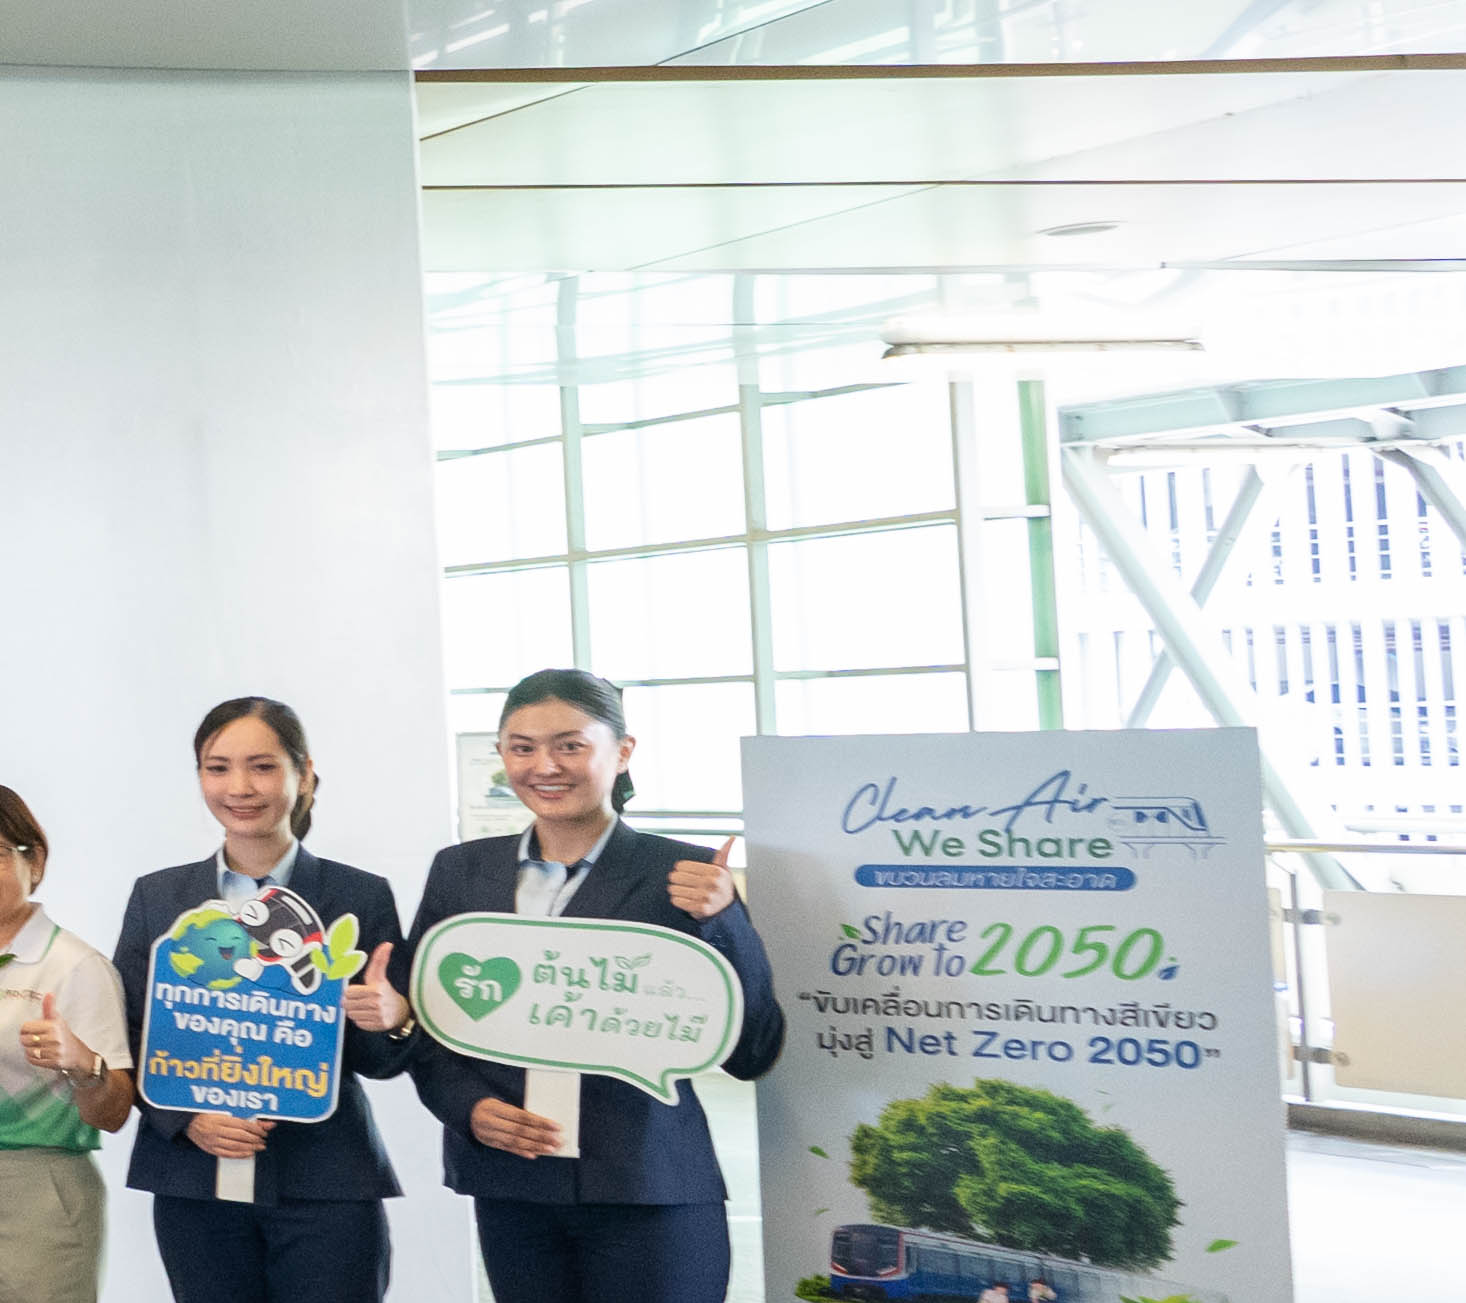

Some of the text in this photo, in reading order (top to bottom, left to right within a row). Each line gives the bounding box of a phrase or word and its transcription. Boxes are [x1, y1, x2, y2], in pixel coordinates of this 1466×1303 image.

[841, 770, 1111, 835] Clean Air
[892, 828, 1115, 860] We Share
[860, 910, 968, 947] Share
[830, 942, 924, 978] Grow
[968, 921, 1166, 982] 2050
[453, 963, 504, 1002] รัก
[155, 981, 337, 1025] ทุกการเดินทาง
[172, 1011, 314, 1048] ของคุณ คือ
[885, 1027, 958, 1058] Net
[972, 1030, 1072, 1063] Zero
[149, 1044, 330, 1099] ก้าวที่ยิ่งใหญ่
[190, 1085, 279, 1112] ของเรา
